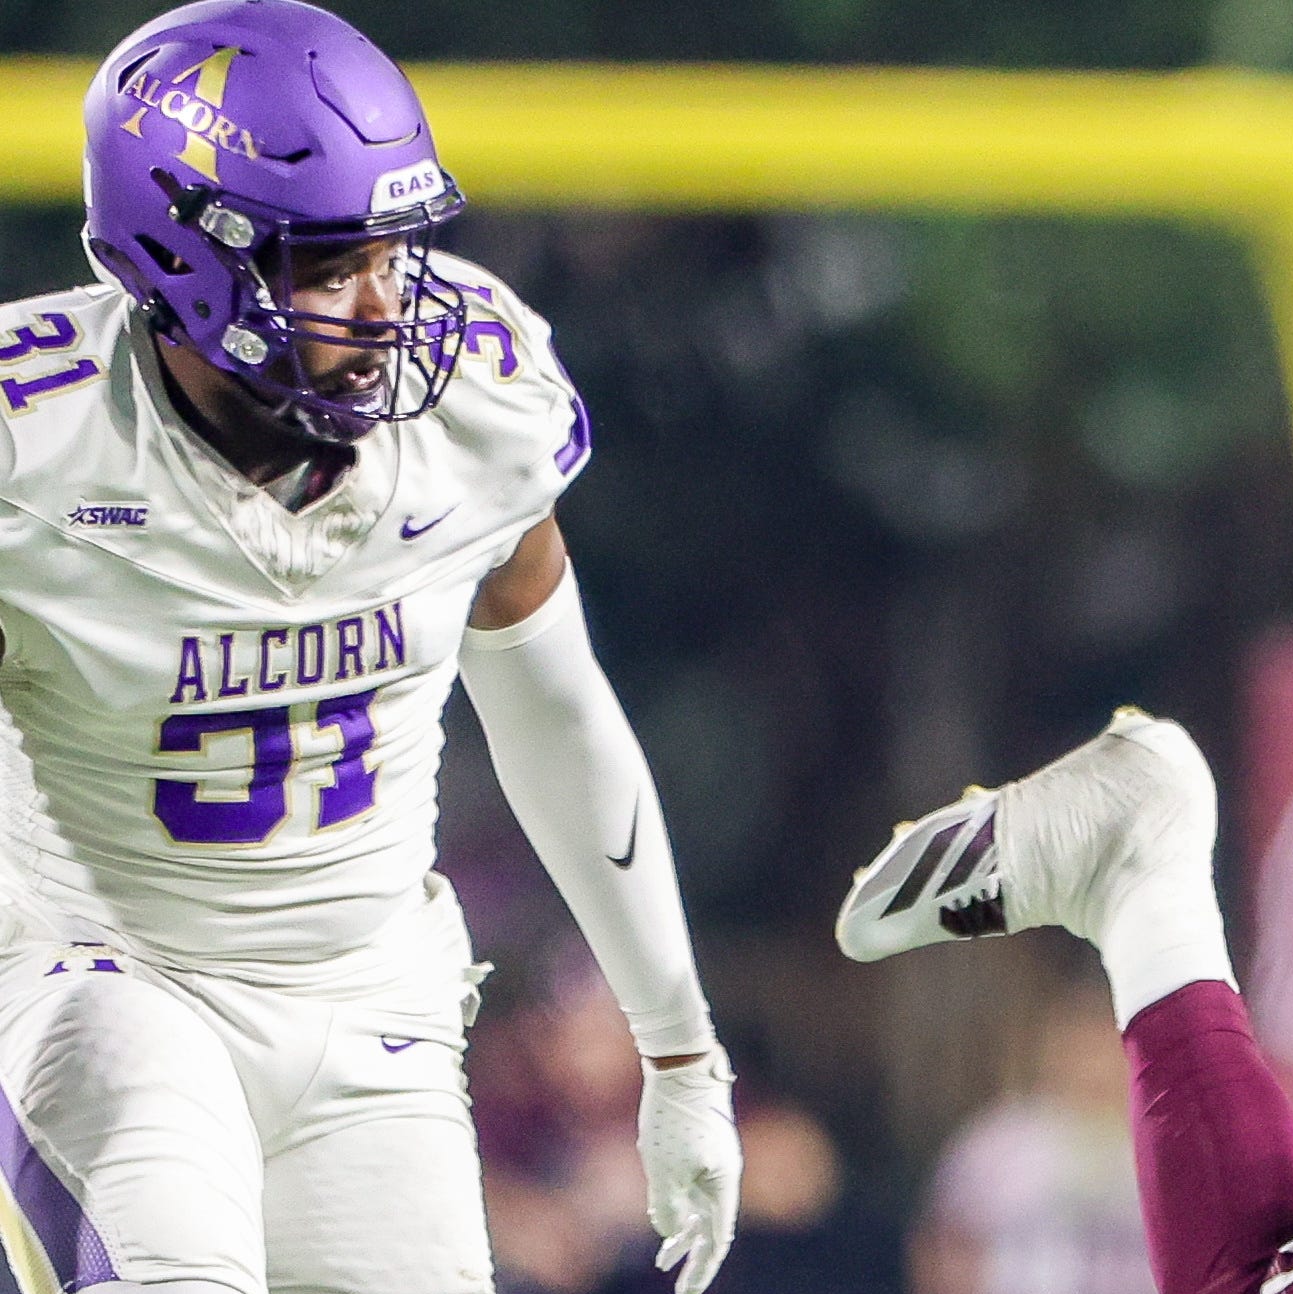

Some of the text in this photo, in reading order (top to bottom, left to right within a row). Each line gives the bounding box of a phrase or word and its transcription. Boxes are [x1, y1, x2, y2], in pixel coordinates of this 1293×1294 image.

[126, 72, 266, 160] ALCORN
[389, 172, 434, 198] GAS
[0, 313, 102, 413] 31
[85, 506, 148, 526] SWAC
[169, 602, 405, 703] ALCORN
[152, 689, 382, 846] 31
